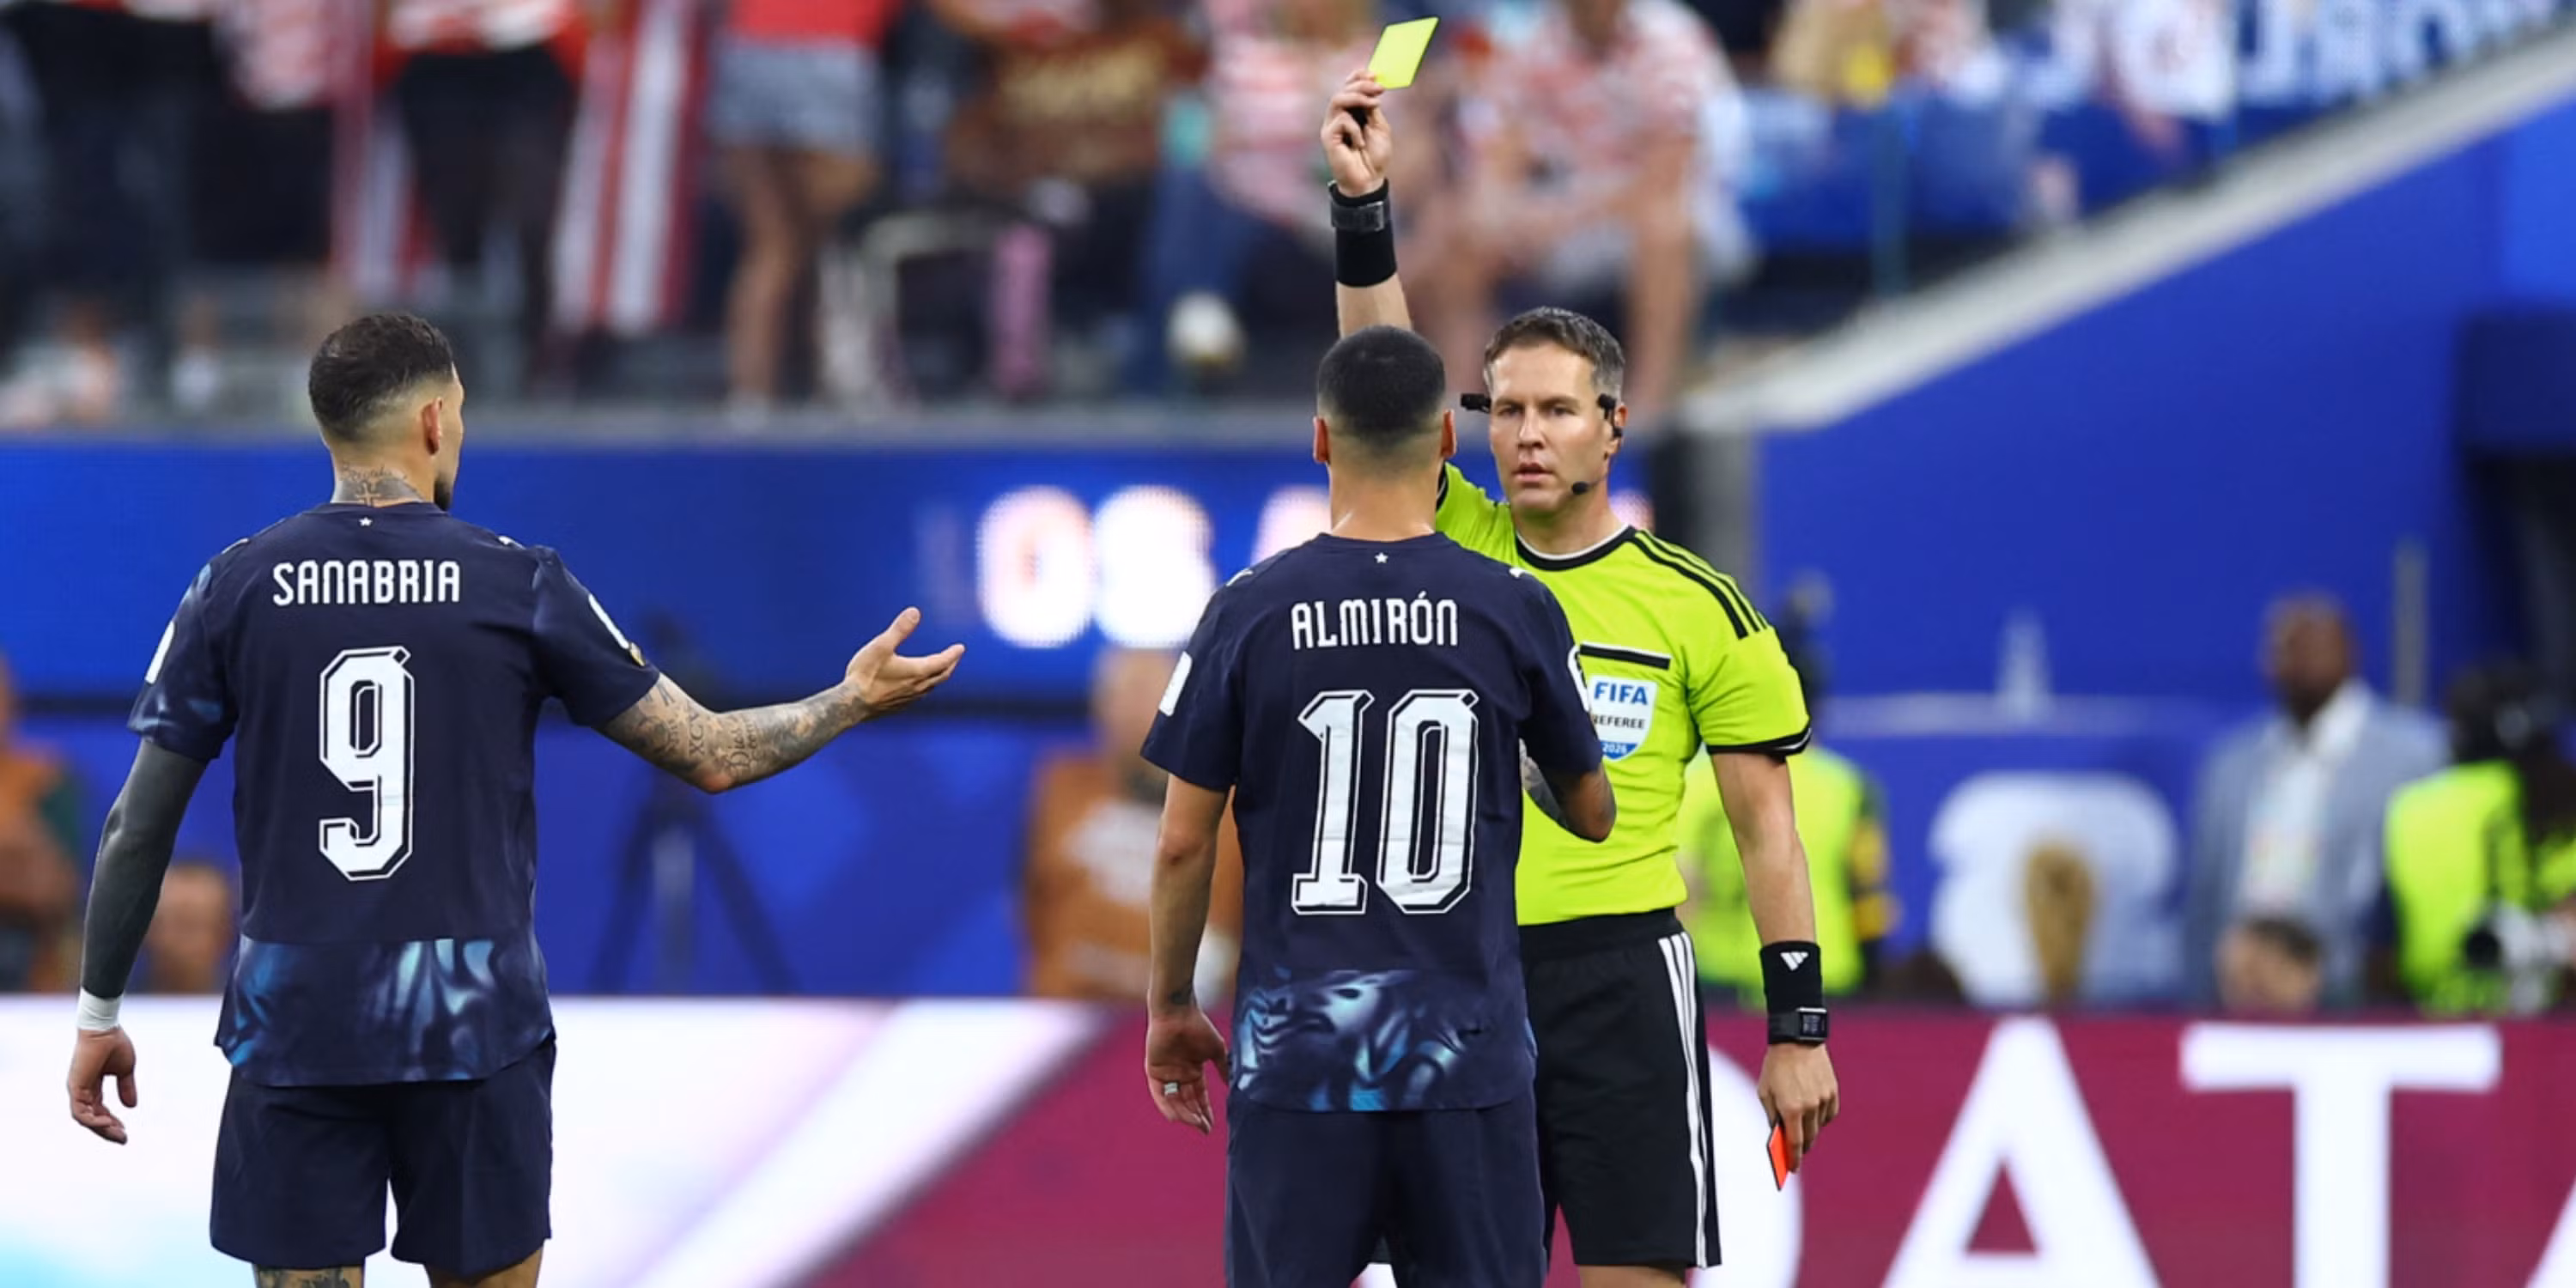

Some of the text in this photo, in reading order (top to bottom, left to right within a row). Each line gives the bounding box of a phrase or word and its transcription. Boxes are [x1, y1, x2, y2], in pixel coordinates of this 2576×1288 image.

[273, 560, 460, 605] SANABRIA
[1291, 590, 1458, 650] ALMIRÓN
[1594, 681, 1648, 705] FIFA
[319, 646, 413, 881] 9
[1291, 690, 1479, 915] 10
